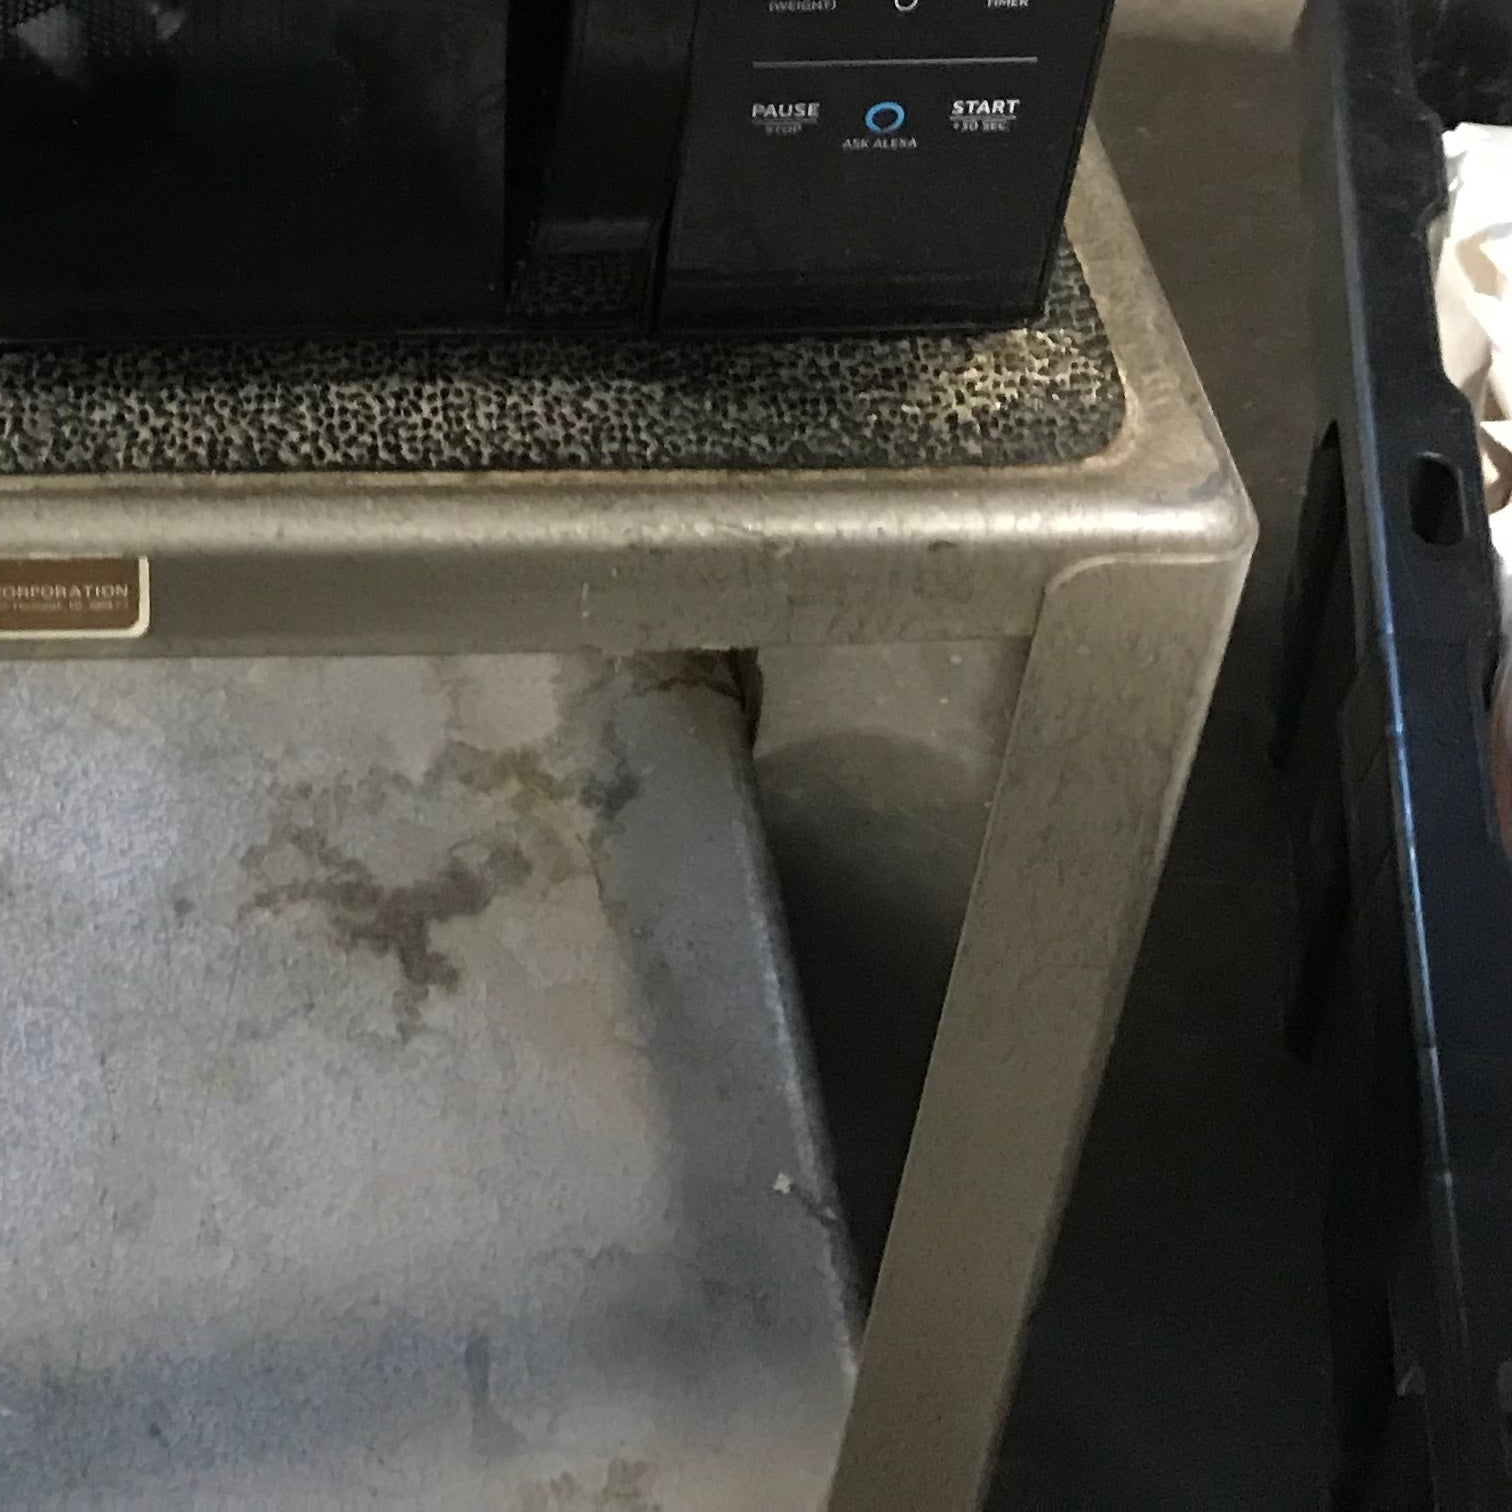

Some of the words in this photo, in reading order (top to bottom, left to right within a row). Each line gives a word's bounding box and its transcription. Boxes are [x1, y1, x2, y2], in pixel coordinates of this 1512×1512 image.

[751, 101, 821, 118] PAUSE
[951, 98, 1021, 115] START
[872, 136, 918, 151] ALEXA
